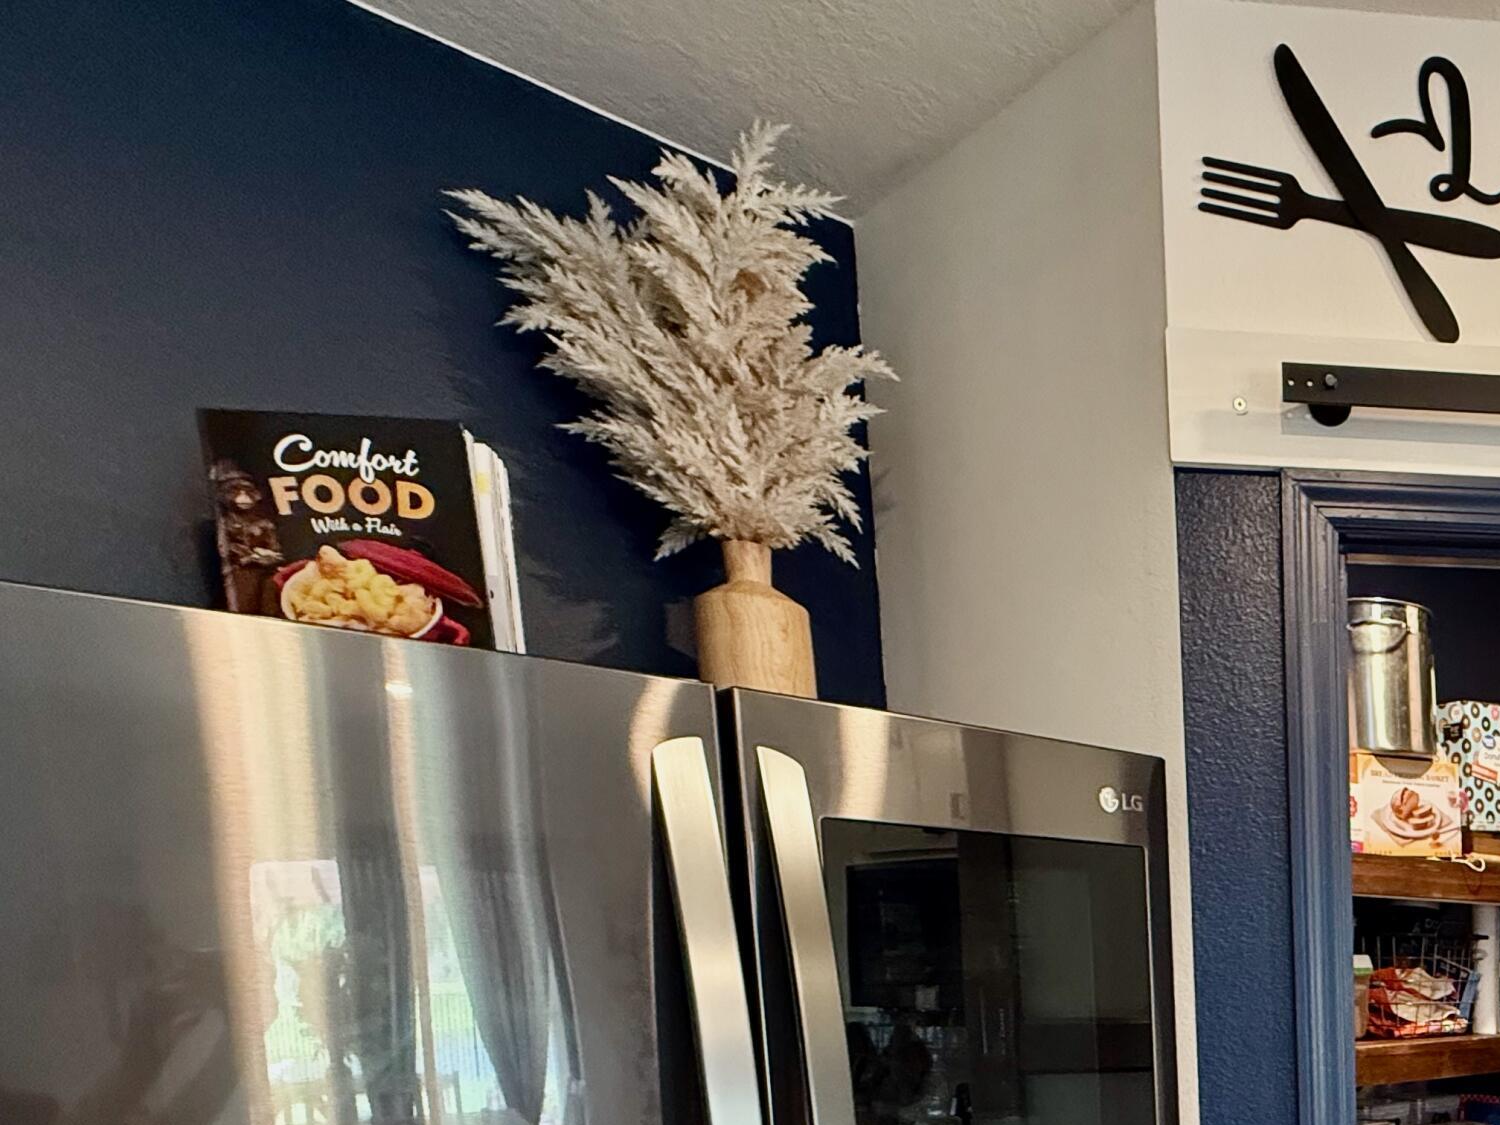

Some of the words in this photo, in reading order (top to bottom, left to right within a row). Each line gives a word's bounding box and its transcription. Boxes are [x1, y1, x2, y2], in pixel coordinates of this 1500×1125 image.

[273, 433, 420, 484] Comfort
[268, 473, 436, 520] FOOD
[310, 516, 349, 535] With
[352, 522, 362, 533] a
[364, 517, 403, 537] Flair
[1121, 793, 1144, 812] LG
